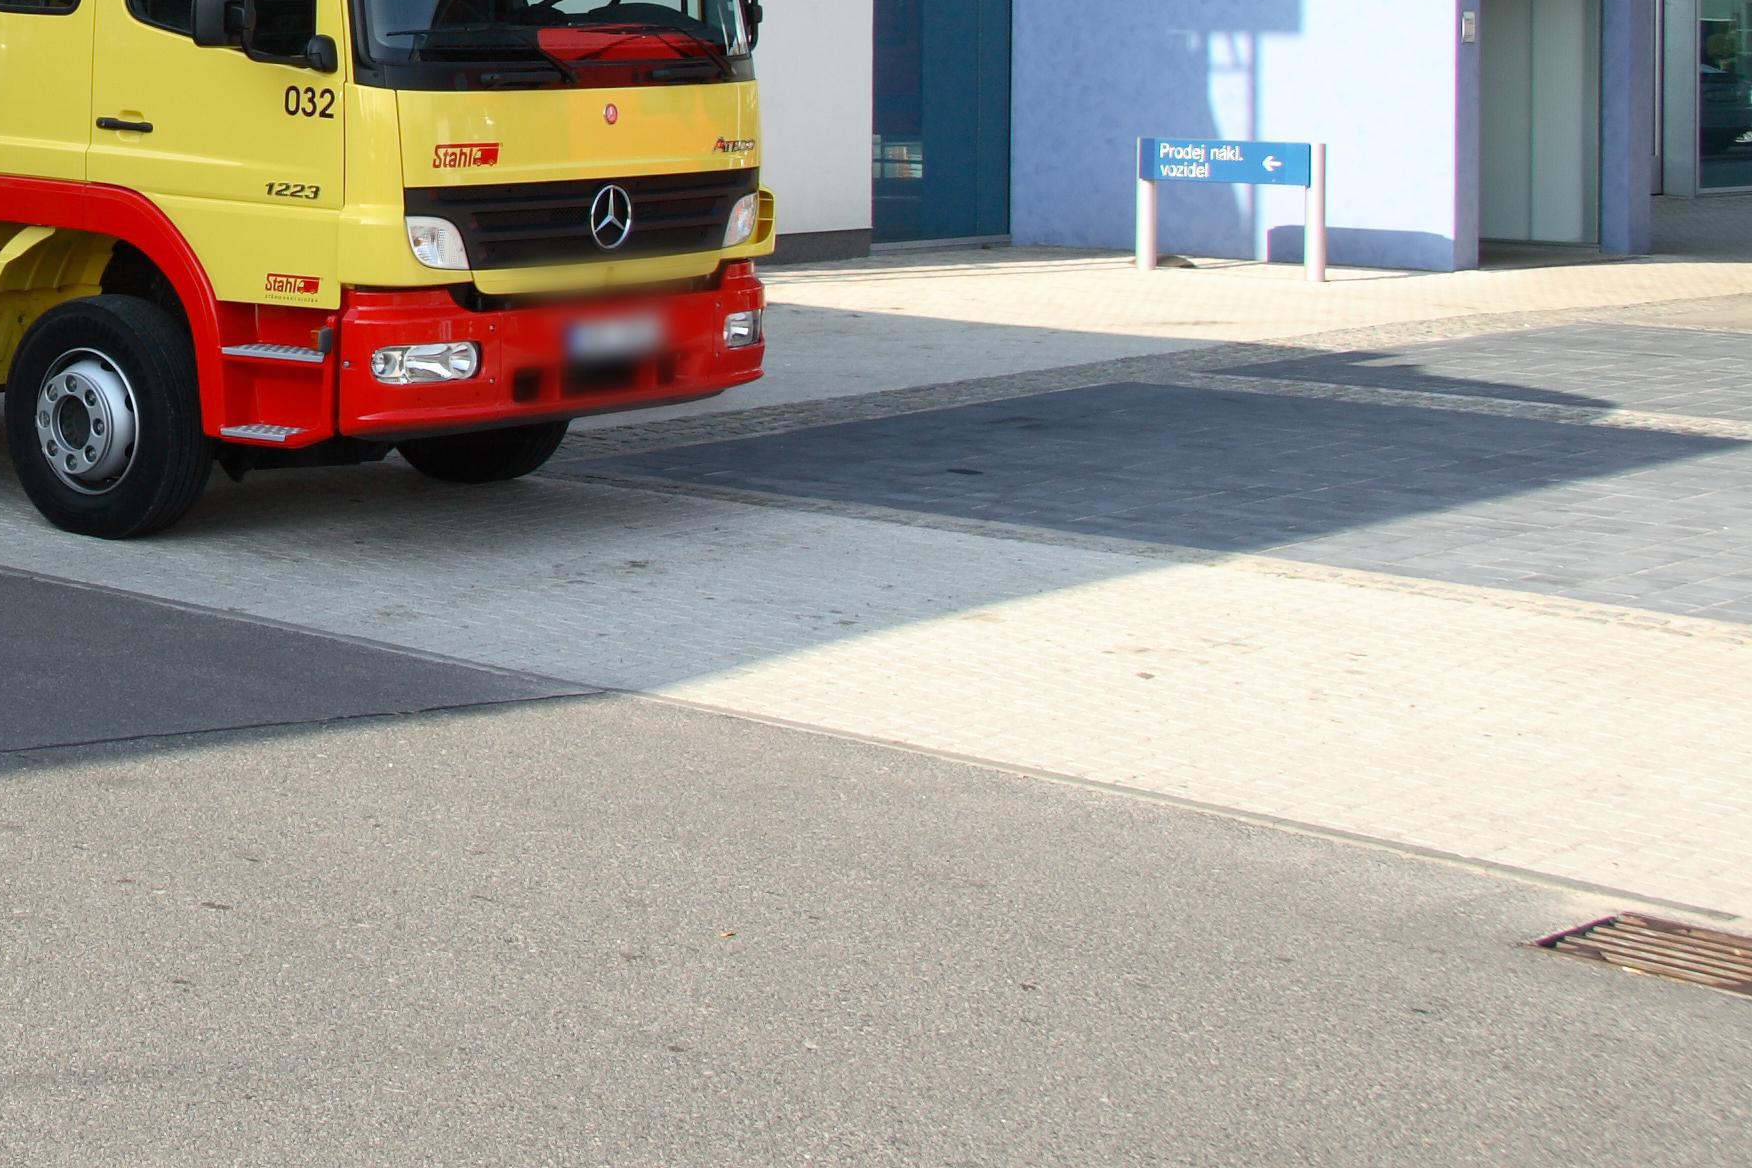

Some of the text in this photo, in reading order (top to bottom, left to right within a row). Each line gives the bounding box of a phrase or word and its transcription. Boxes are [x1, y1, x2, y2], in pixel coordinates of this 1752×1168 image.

[284, 85, 335, 119] 032
[1160, 142, 1244, 162] Prodej nákl.
[1160, 162, 1210, 178] vozidel
[265, 182, 321, 200] 1223
